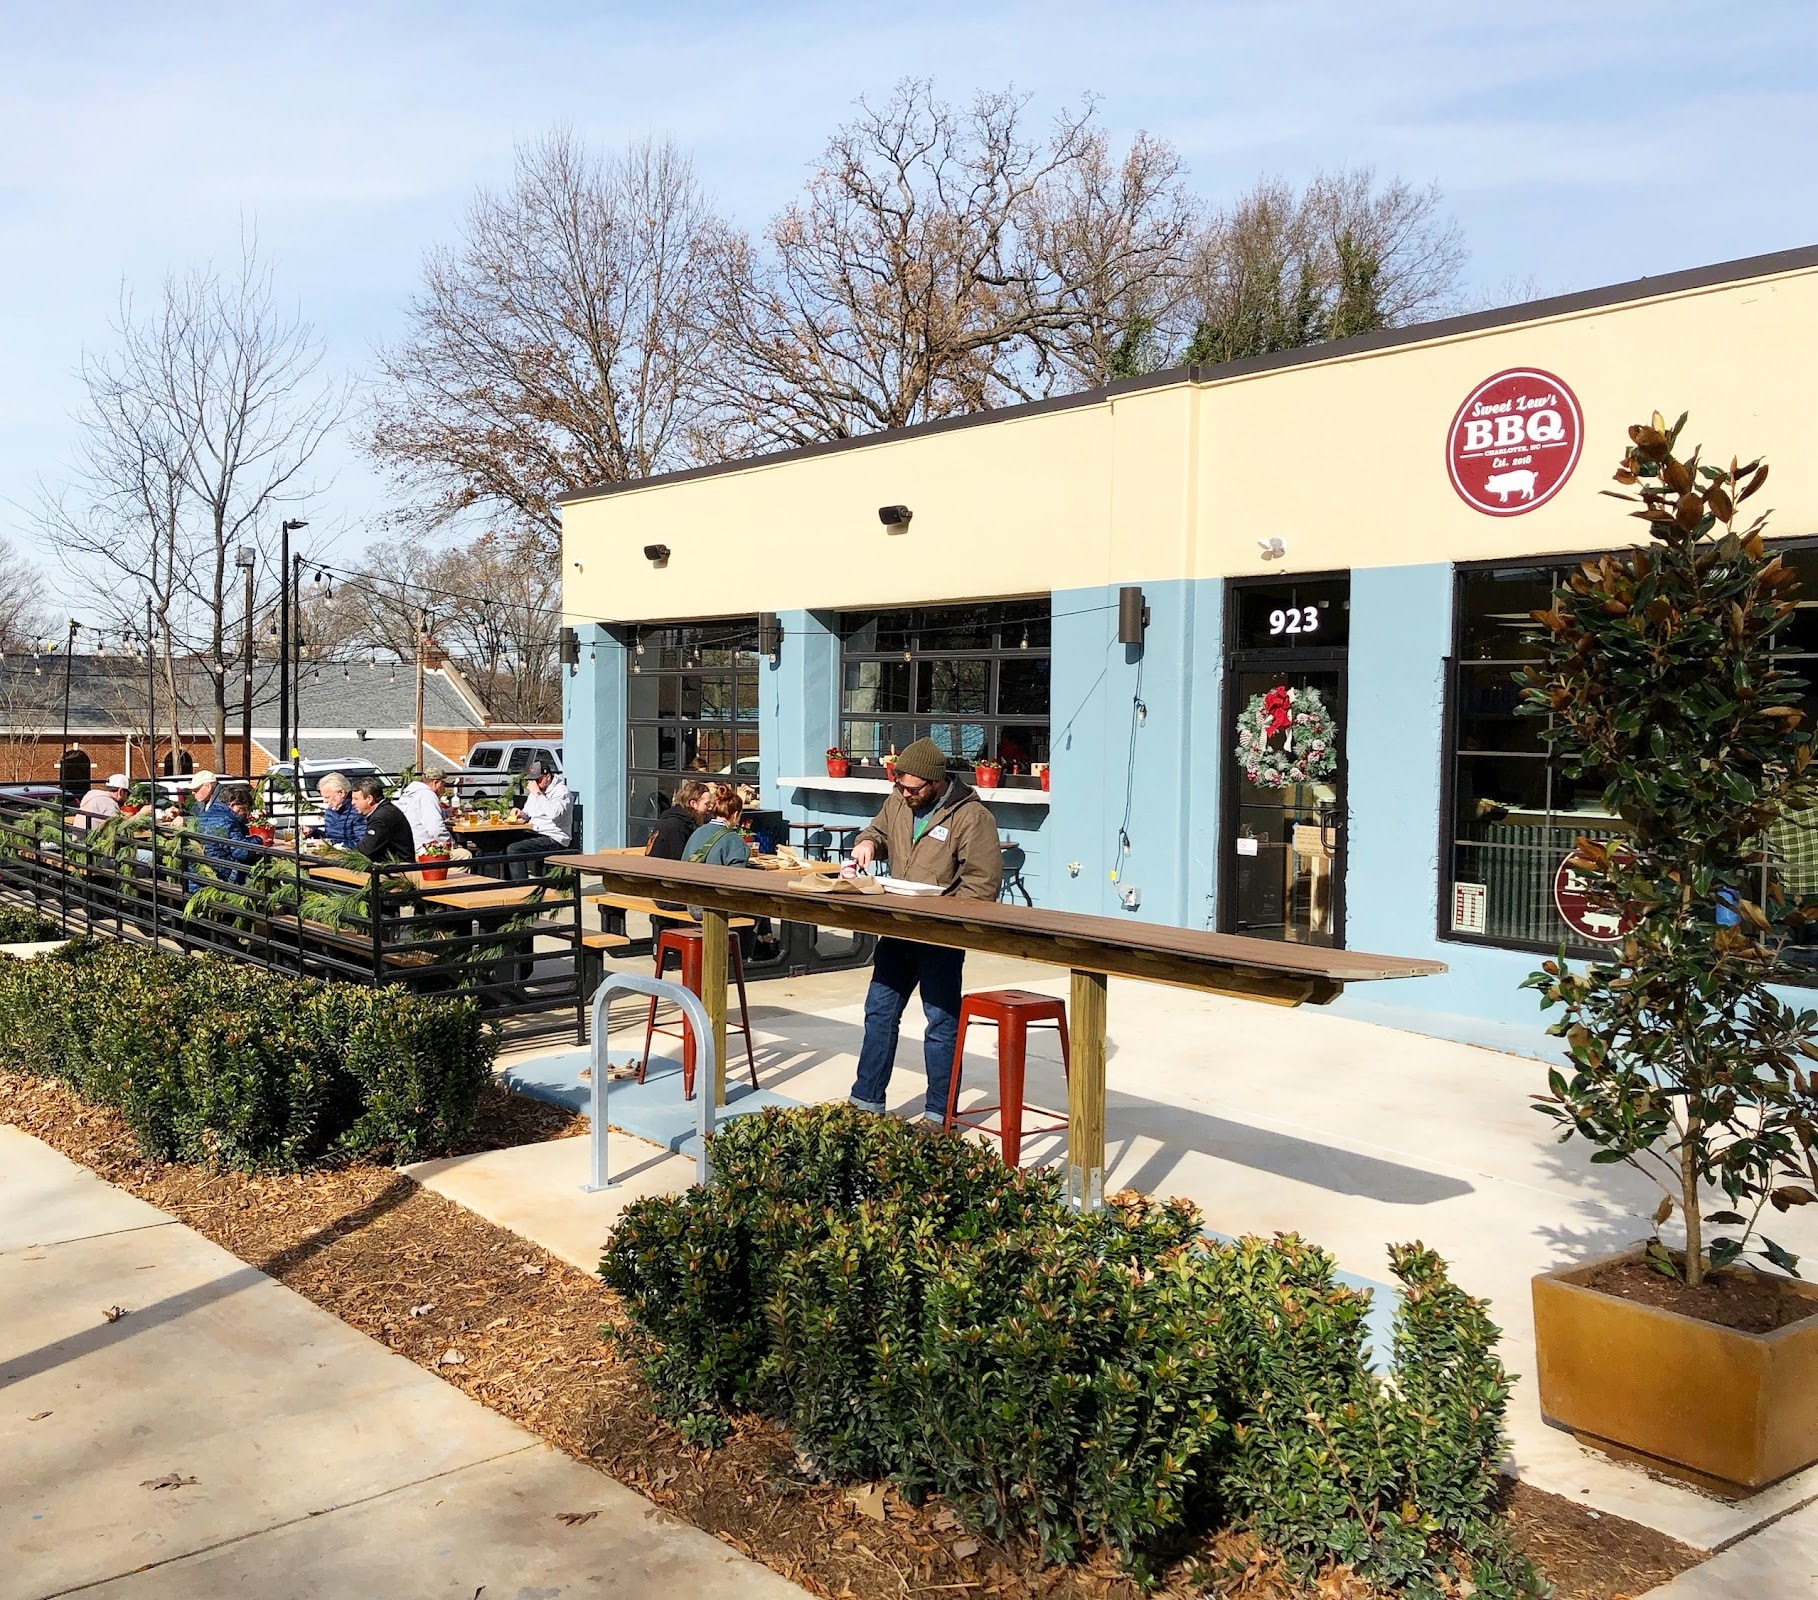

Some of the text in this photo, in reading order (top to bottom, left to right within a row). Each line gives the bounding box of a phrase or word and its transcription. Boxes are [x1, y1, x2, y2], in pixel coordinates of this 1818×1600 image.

[1472, 394, 1557, 417] Sweet Lew's
[1463, 410, 1565, 451] BBQ
[1269, 606, 1318, 635] 923
